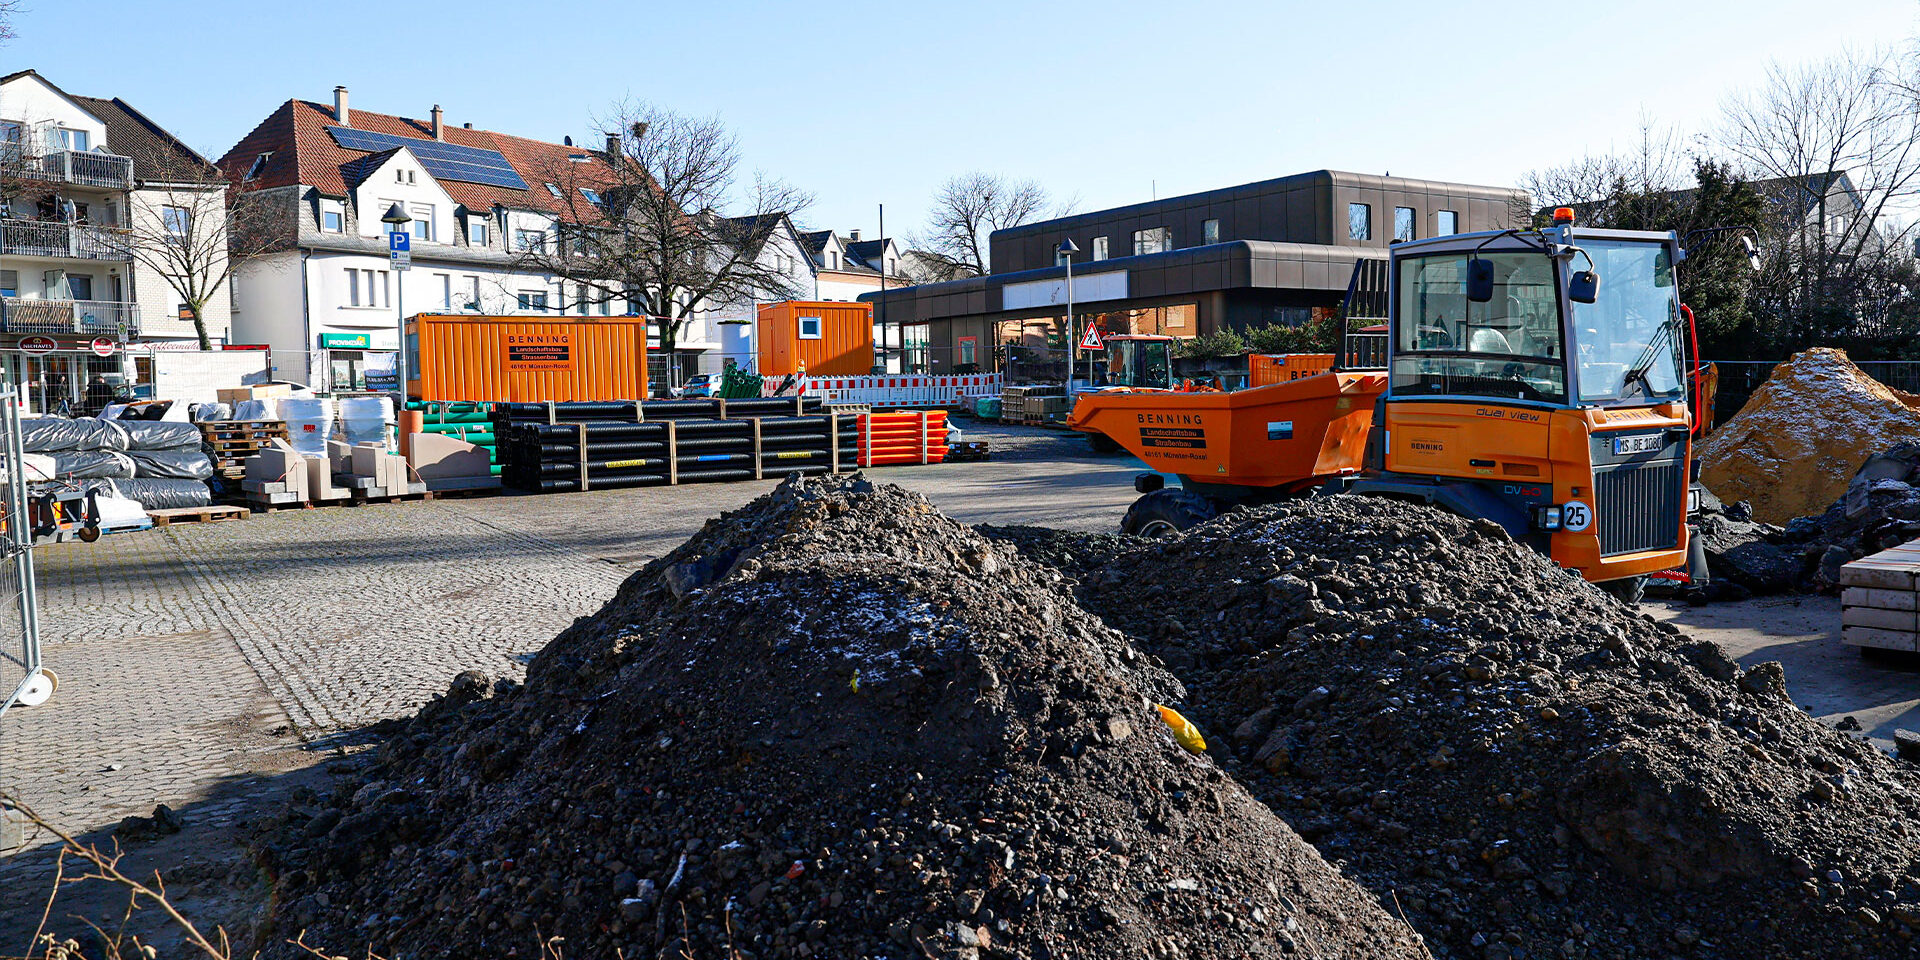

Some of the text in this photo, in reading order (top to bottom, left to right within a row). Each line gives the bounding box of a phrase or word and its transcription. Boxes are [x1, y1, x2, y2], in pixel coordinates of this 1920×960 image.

[394, 234, 405, 248] P
[508, 335, 569, 343] BENNING
[1137, 413, 1202, 425] BENNING
[1476, 407, 1540, 422] dual view
[1146, 428, 1197, 437] Landschaftsbau
[1154, 439, 1192, 448] Straßenbau
[1411, 442, 1443, 451] BENNING
[1620, 439, 1629, 452] MS
[1634, 438, 1643, 451] BE
[1566, 506, 1585, 526] 25
